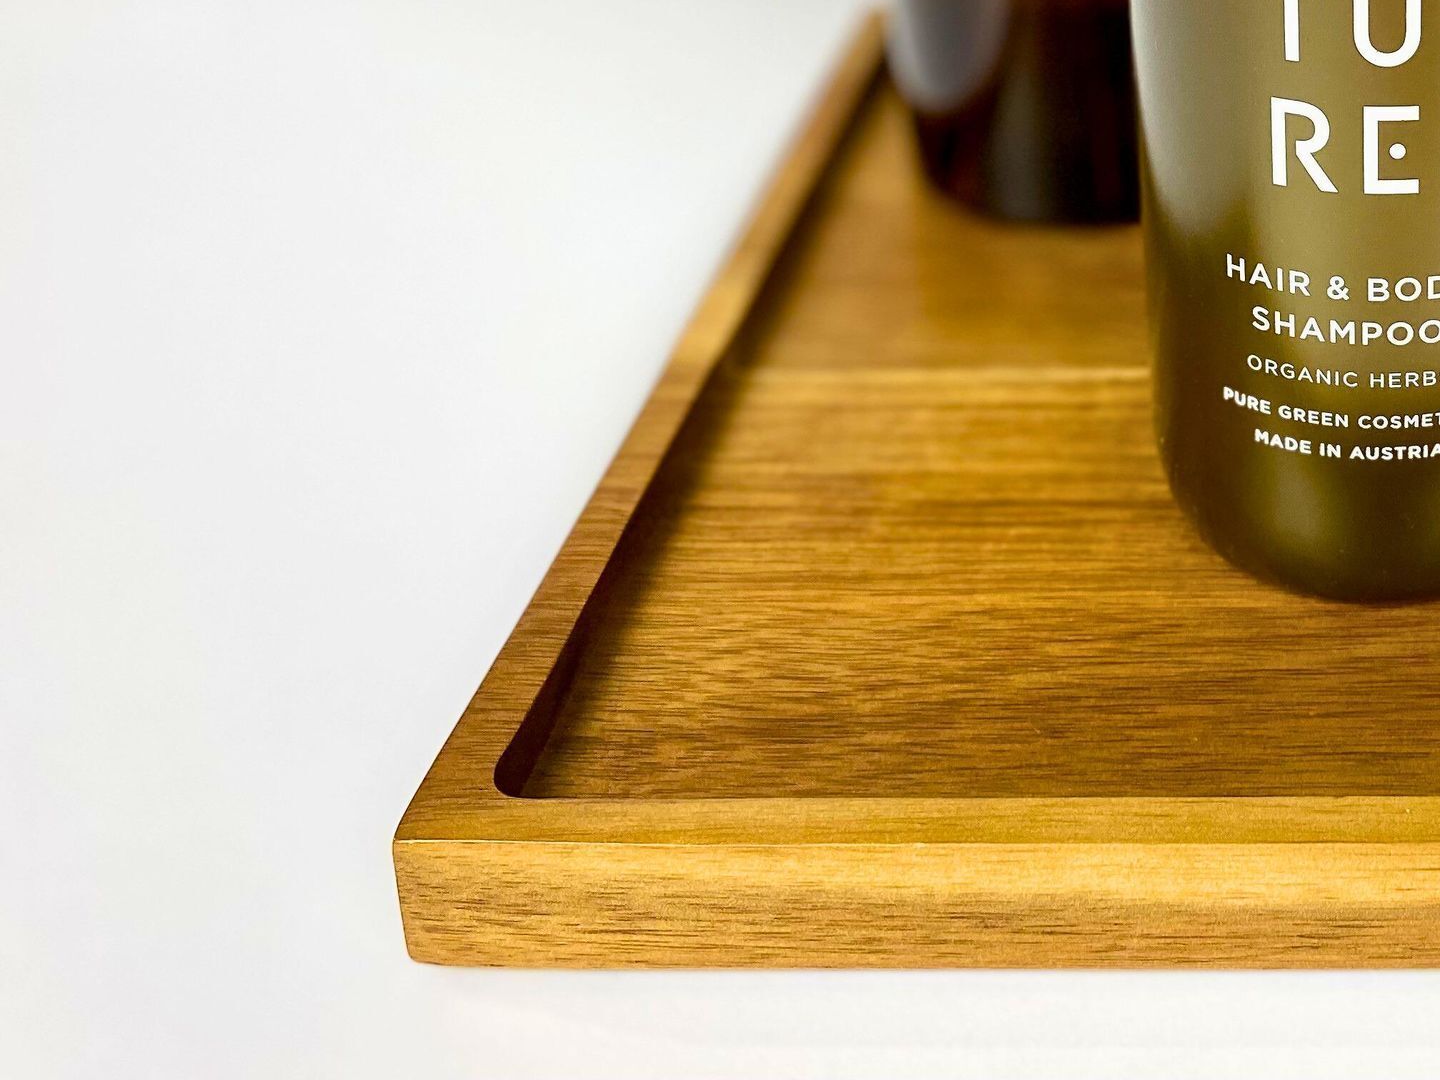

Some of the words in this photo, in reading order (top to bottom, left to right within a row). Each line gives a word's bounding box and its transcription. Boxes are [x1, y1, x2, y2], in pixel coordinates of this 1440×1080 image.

[1270, 96, 1420, 195] RE
[1226, 253, 1311, 297] HAIR
[1326, 275, 1350, 301] &
[1246, 354, 1359, 388] ORGANIC
[1222, 386, 1272, 416] PURE
[1278, 405, 1349, 428] GREEN
[1254, 428, 1312, 455] MADE
[1319, 442, 1342, 458] IN
